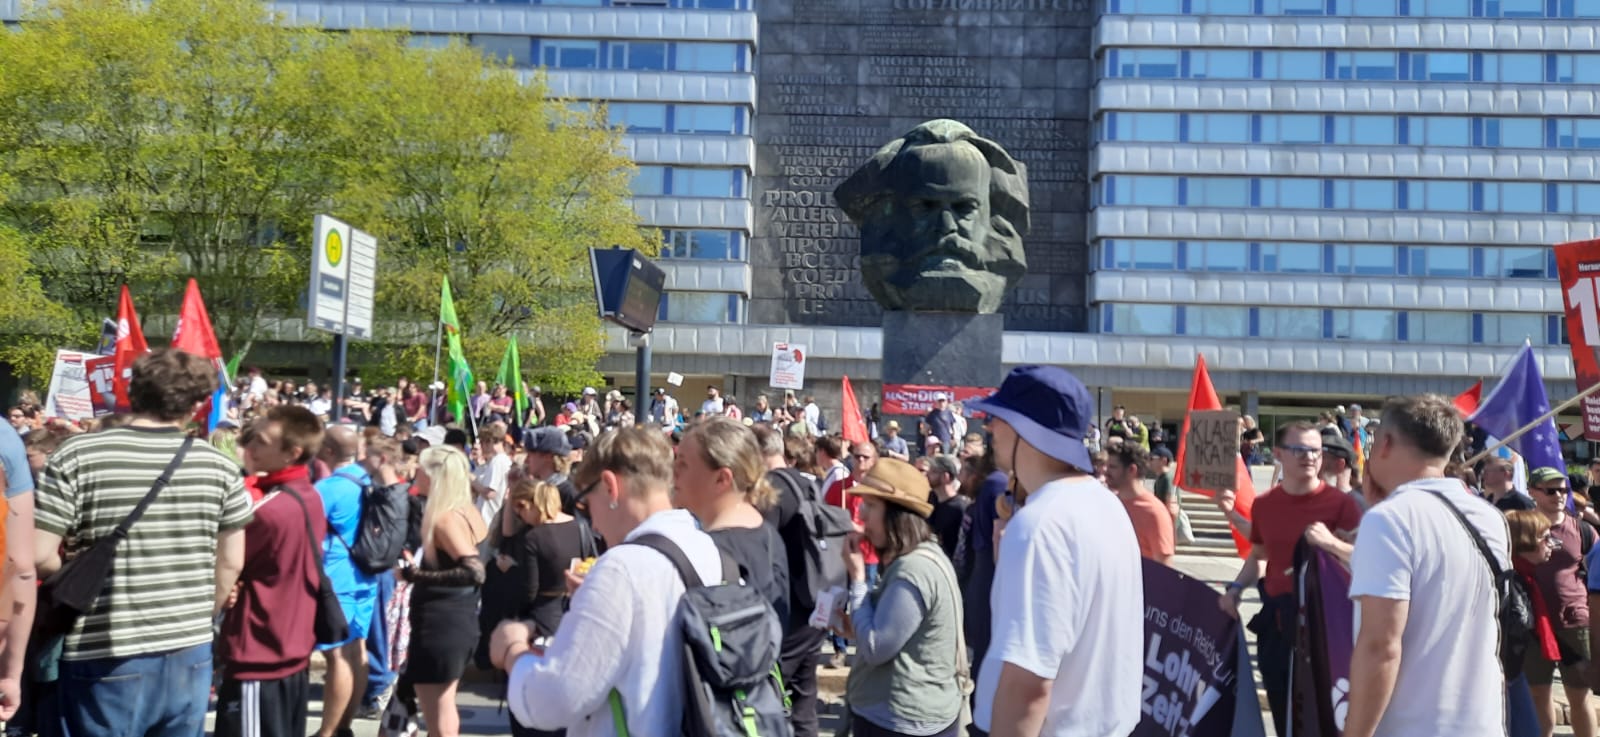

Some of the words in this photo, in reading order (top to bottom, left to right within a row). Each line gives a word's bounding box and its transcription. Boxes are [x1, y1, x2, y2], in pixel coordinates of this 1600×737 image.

[771, 206, 838, 222] ALLER
[773, 222, 860, 238] VEREIN
[1171, 616, 1194, 642] den
